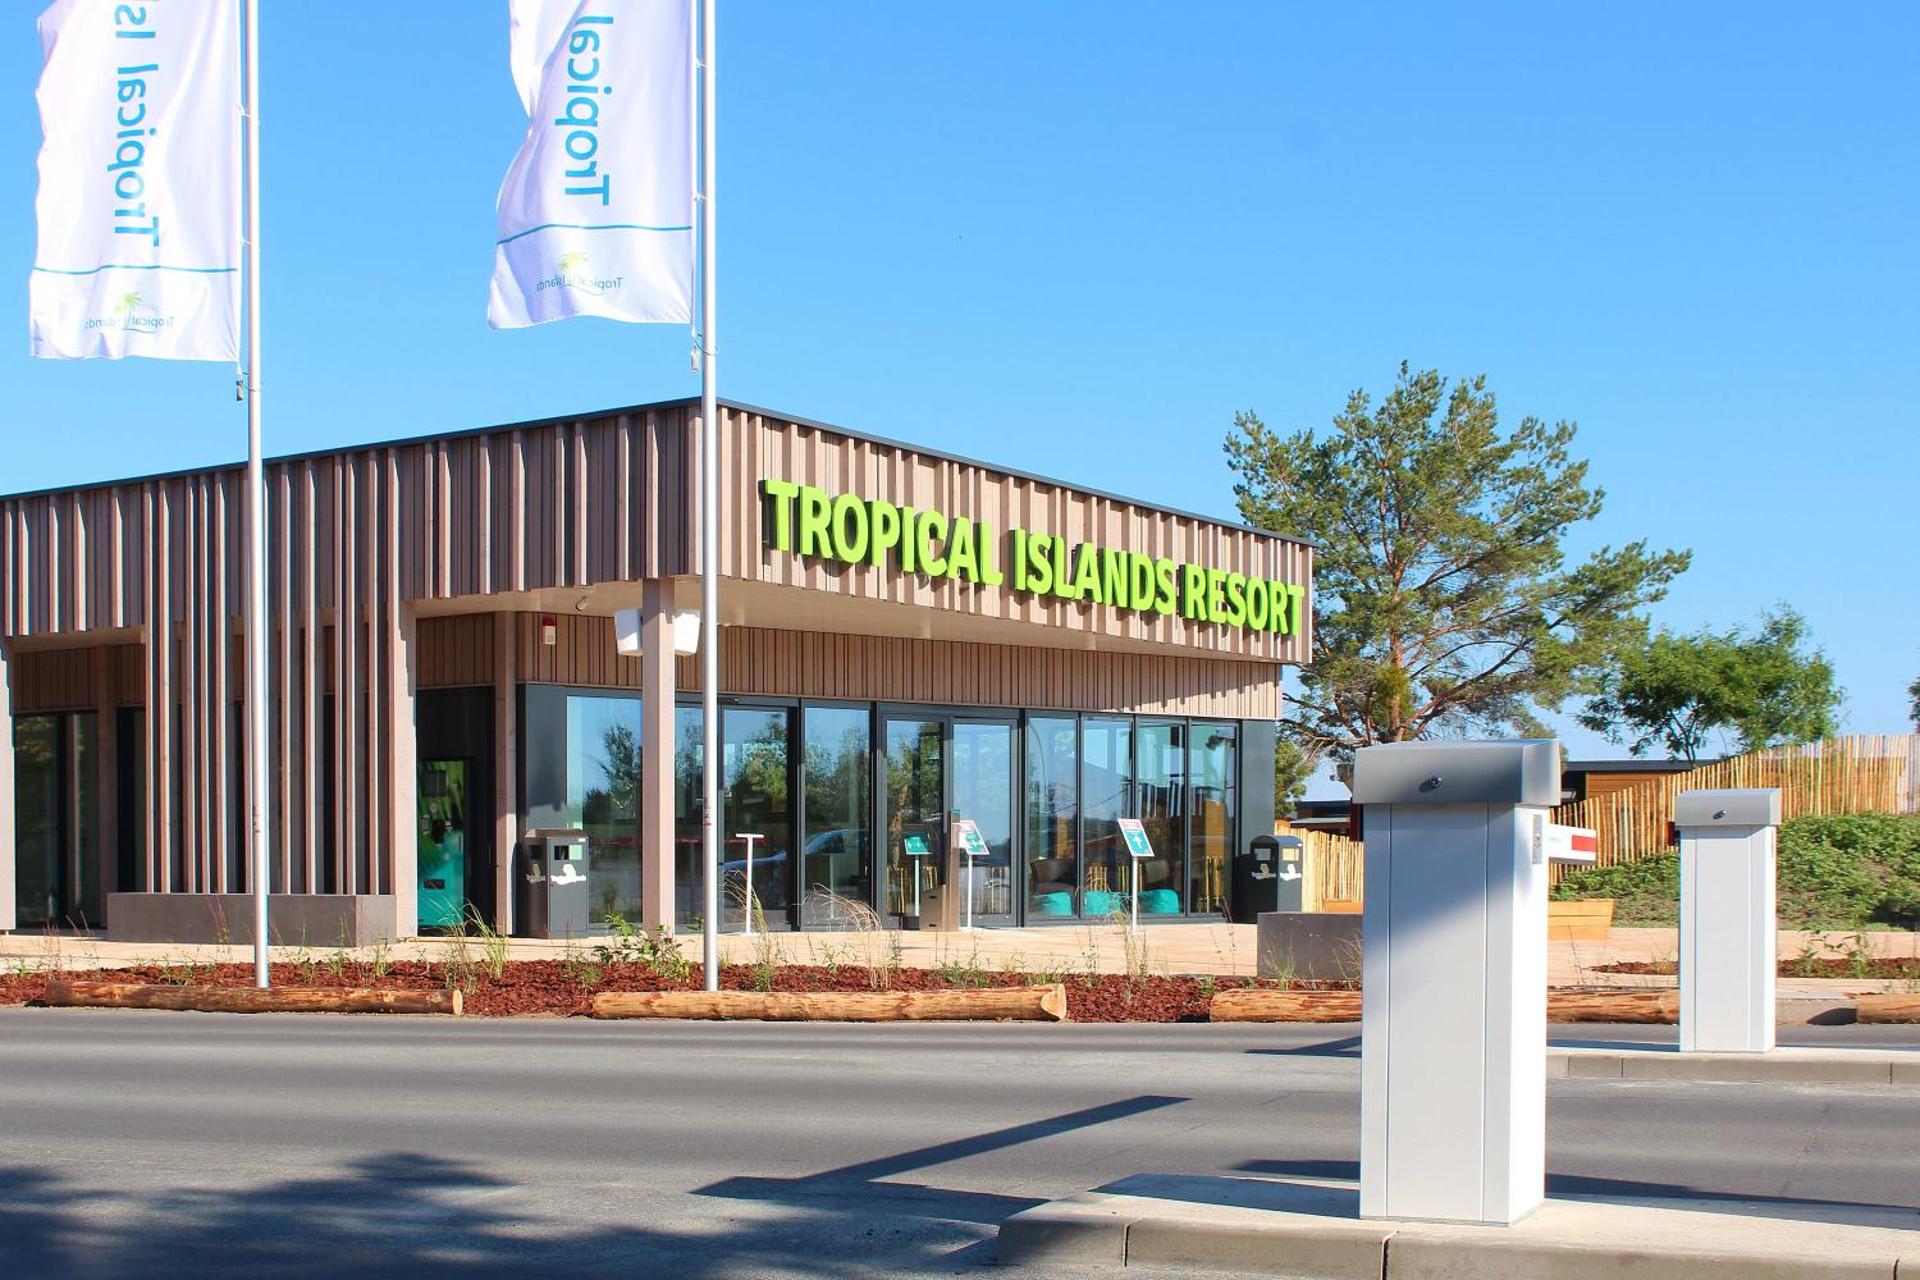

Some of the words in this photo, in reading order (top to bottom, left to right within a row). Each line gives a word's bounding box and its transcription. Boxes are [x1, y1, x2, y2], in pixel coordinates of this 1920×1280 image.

[762, 479, 1003, 586] TROPICAL
[1010, 528, 1175, 616] ISLANDS
[1182, 563, 1305, 636] RESORT
